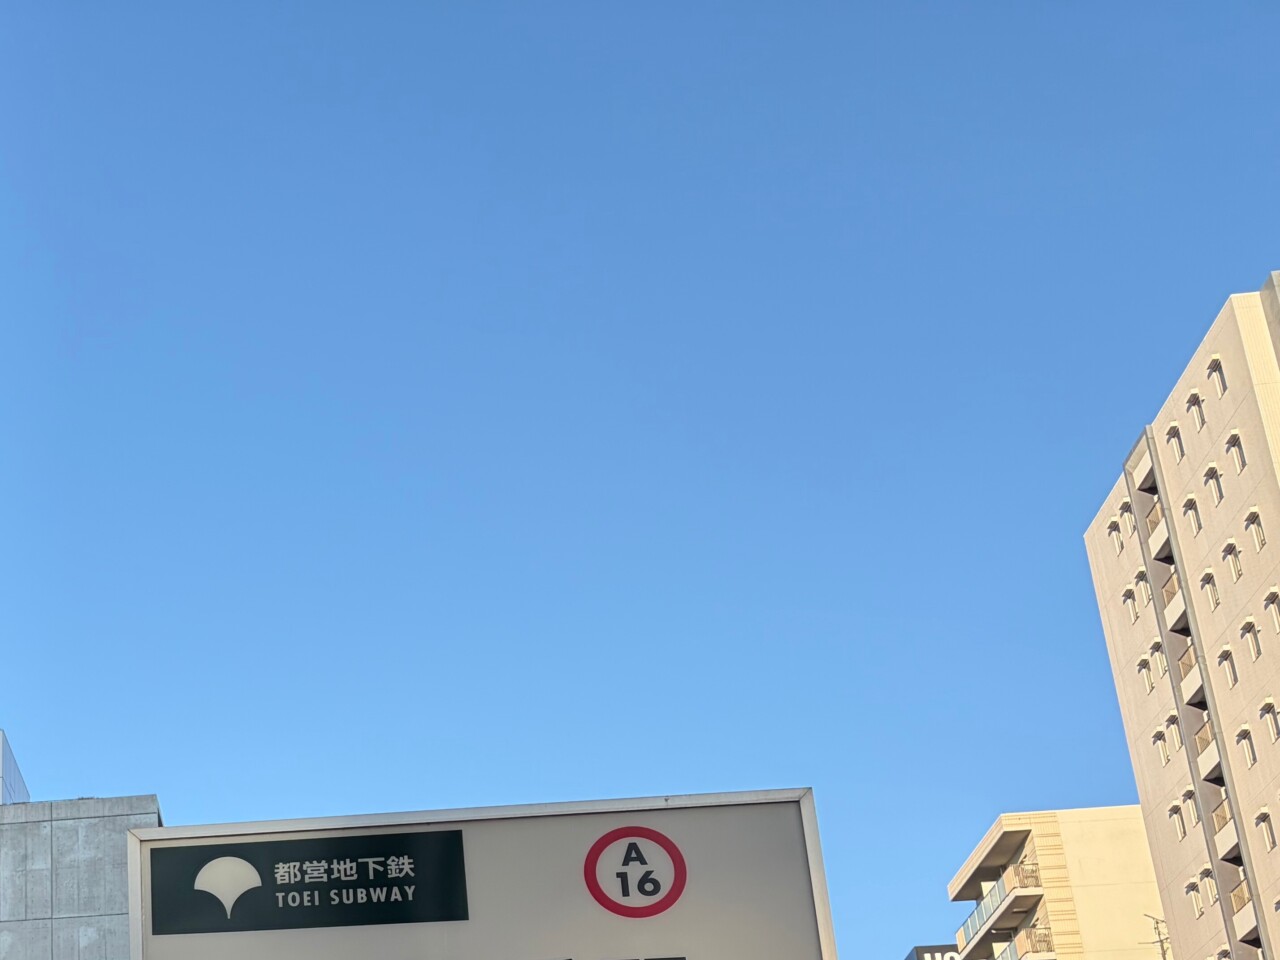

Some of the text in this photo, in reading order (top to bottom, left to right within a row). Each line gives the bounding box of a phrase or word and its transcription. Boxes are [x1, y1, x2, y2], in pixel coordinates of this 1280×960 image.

[621, 842, 648, 867] A
[273, 855, 416, 885] 都営地下鉄
[275, 884, 417, 908] TOEI SUBWAY
[616, 870, 662, 898] 16
